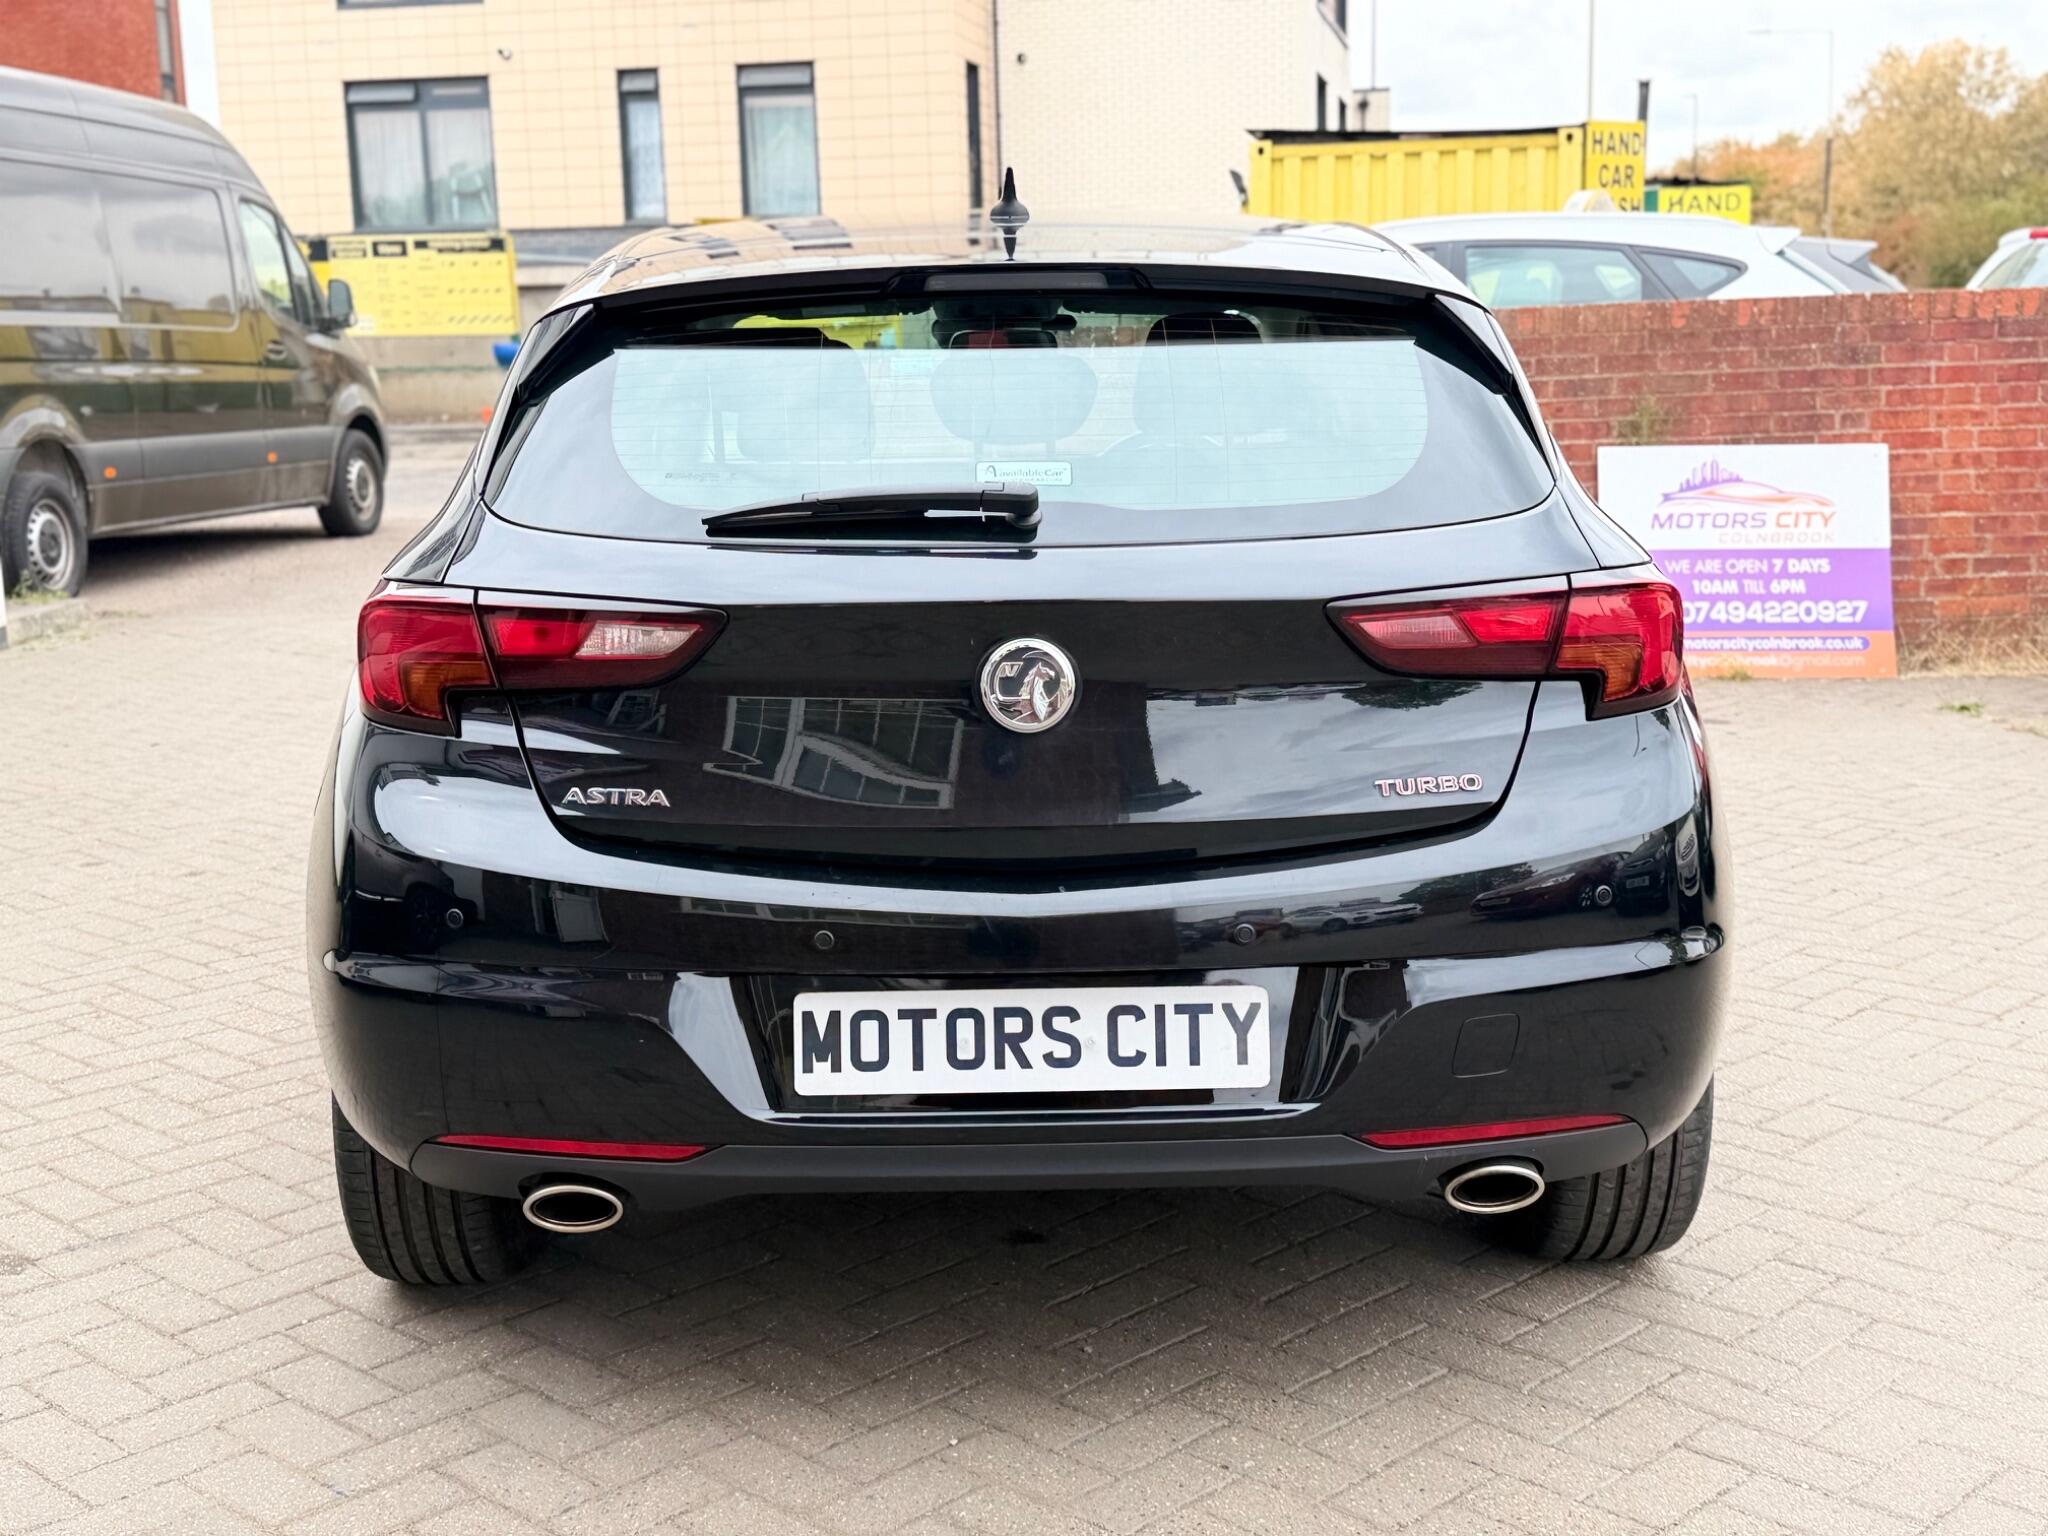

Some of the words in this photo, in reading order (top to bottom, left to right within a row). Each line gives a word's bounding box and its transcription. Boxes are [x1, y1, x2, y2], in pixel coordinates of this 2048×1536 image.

[1592, 131, 1641, 156] HAND
[1599, 164, 1635, 188] CAR
[1668, 192, 1741, 213] HAND
[1651, 512, 1767, 529] MOTORS
[1774, 511, 1836, 528] CITY
[1719, 531, 1835, 544] COLNBROOK
[1664, 560, 1690, 574] WE
[1694, 559, 1722, 574] ARE
[1725, 559, 1768, 574] OPEN
[1772, 558, 1785, 574] 7
[1787, 558, 1831, 574] DAYS
[1692, 579, 1739, 594] 10AM
[1743, 579, 1766, 594] TILL
[1770, 579, 1807, 594] 6PM
[1682, 600, 1868, 624] 07494220927
[1374, 774, 1482, 797] TURBO
[562, 786, 670, 807] ASTRA
[802, 1005, 1082, 1074] MOTORS
[1107, 1002, 1262, 1068] CITY
